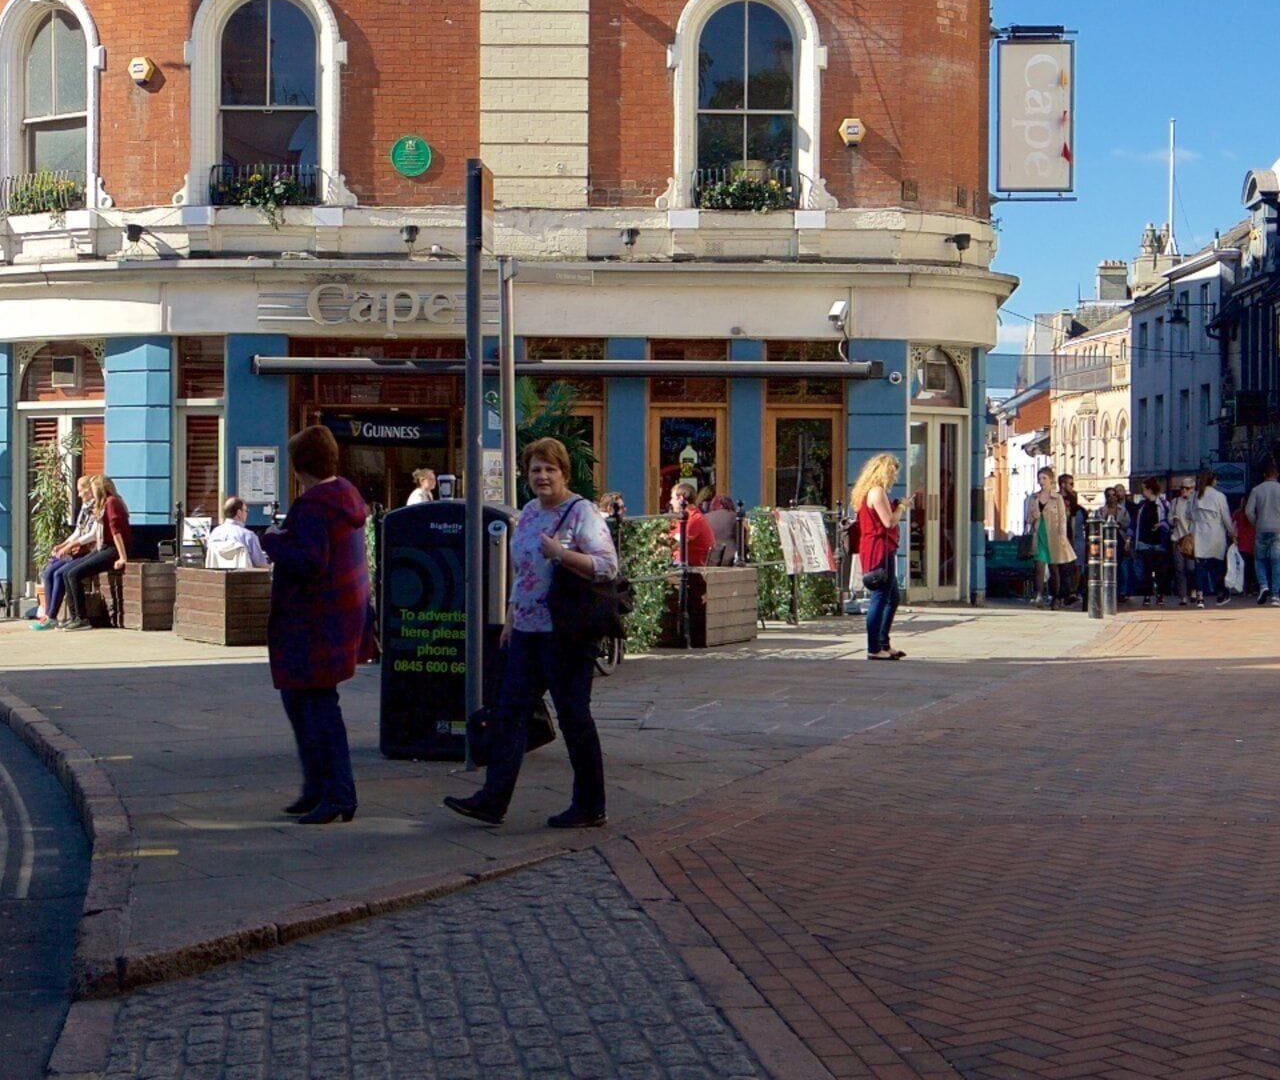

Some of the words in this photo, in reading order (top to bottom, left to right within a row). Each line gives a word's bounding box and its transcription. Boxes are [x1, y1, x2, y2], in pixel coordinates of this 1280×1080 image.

[306, 283, 458, 339] Cape
[363, 423, 421, 439] GUINNESS
[400, 608, 416, 621] To
[419, 608, 467, 622] advertis
[401, 626, 430, 639] here
[432, 626, 466, 641] pleas
[417, 643, 458, 658] phone
[393, 660, 423, 673] 0845
[426, 661, 448, 673] 600
[450, 661, 466, 673] 66
